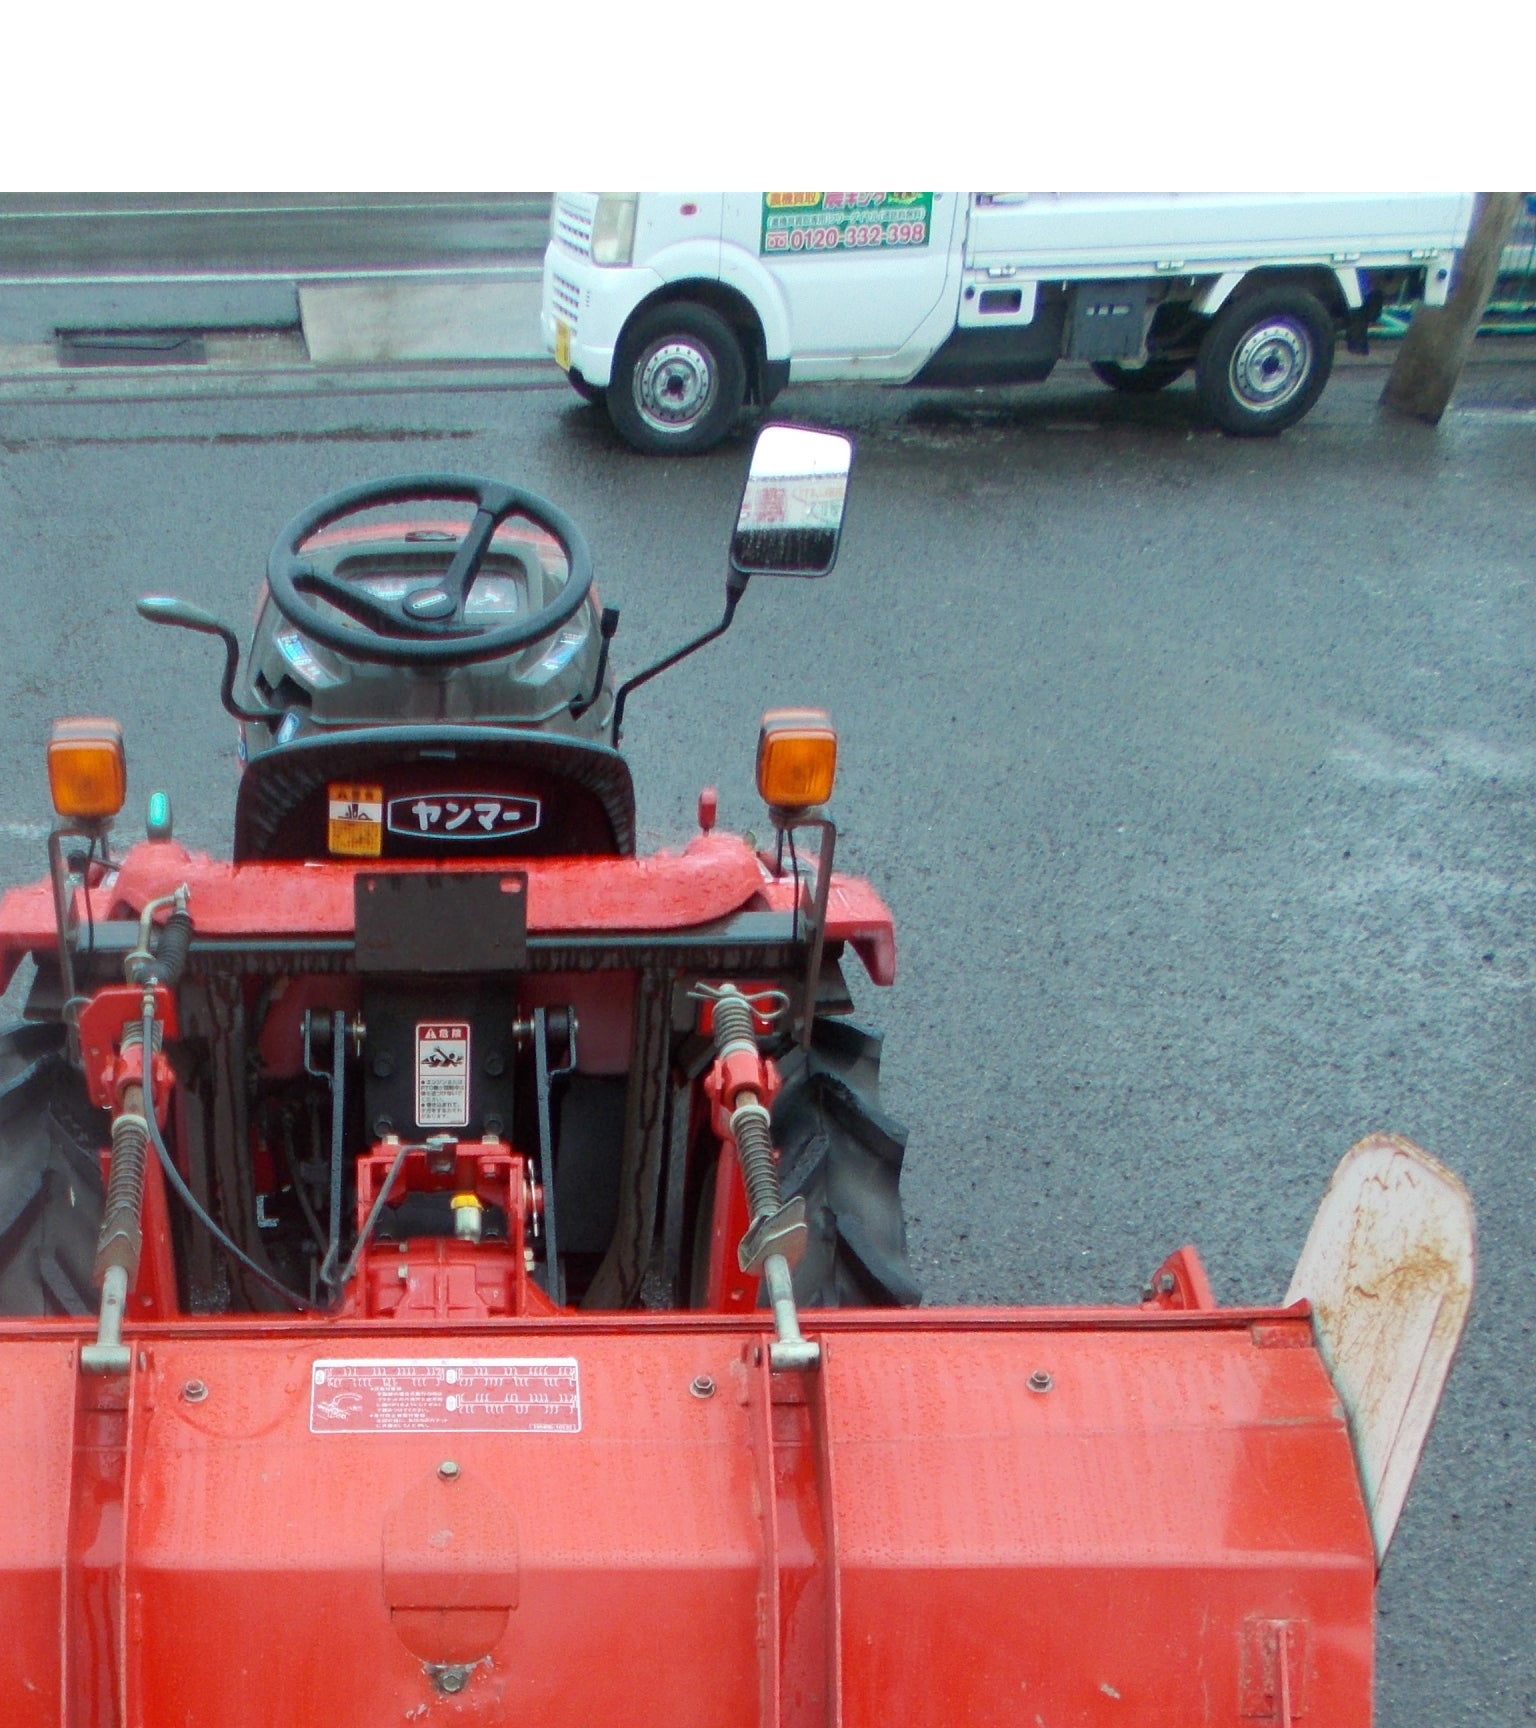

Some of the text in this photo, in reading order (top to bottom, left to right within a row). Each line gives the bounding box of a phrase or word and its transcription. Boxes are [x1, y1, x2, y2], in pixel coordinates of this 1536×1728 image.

[790, 222, 925, 249] 0120-332-398
[411, 801, 521, 831] ヤンマー
[438, 1028, 462, 1039] 危険
